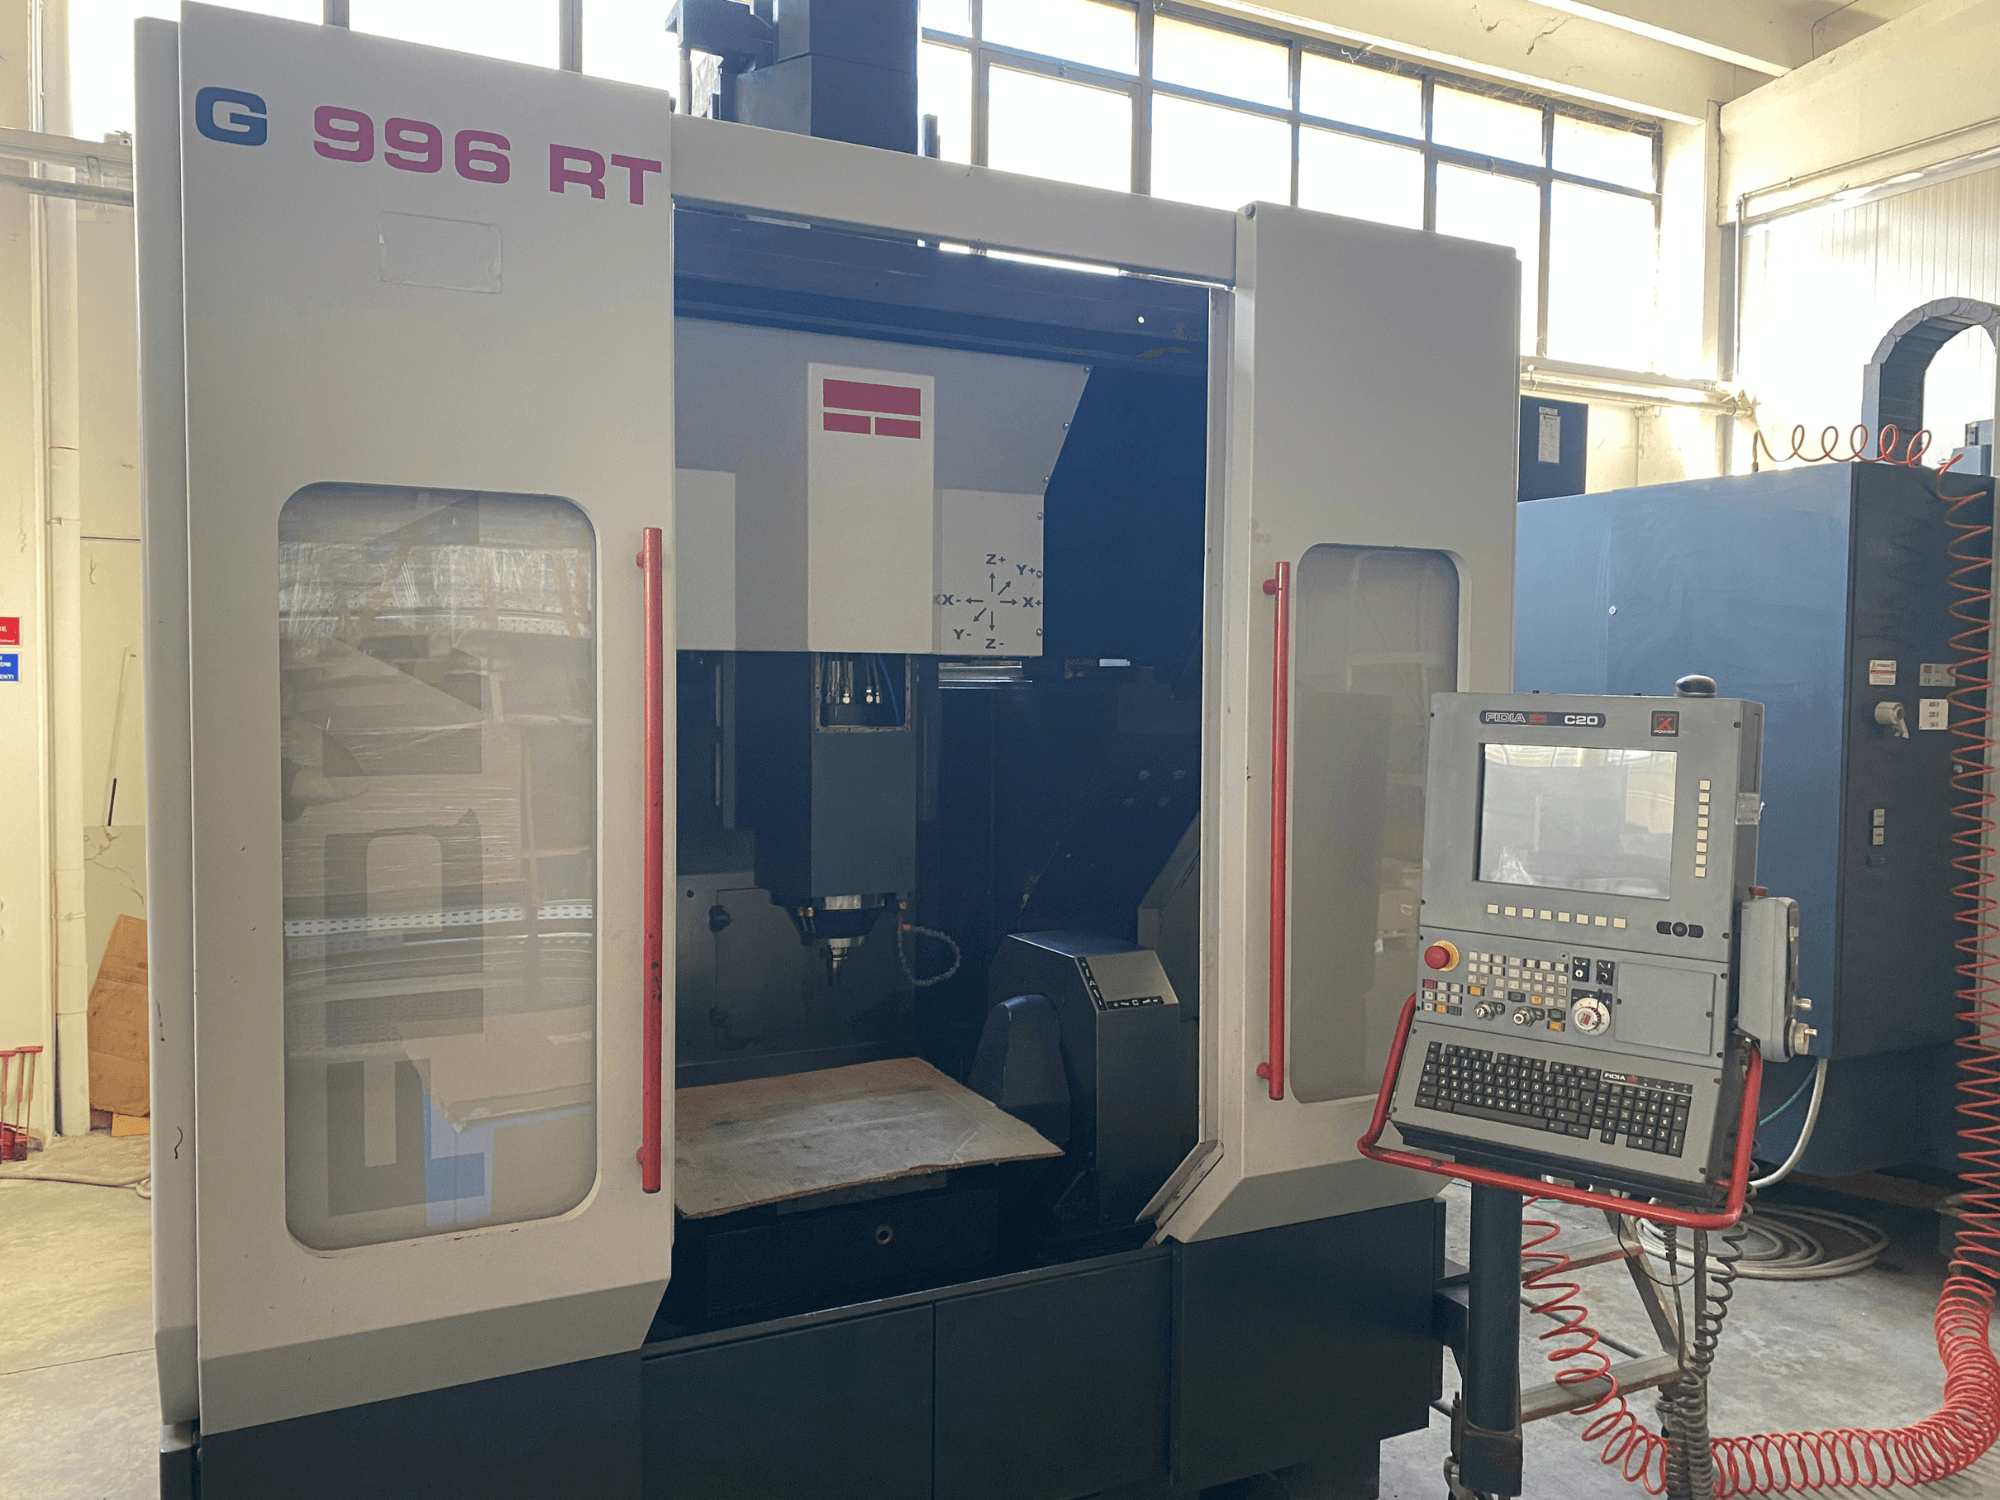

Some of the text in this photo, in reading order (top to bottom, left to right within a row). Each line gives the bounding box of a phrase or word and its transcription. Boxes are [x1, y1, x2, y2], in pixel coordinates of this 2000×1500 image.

[195, 86, 662, 205] G 996 RT
[986, 553, 1006, 565] Z+
[1022, 596, 1042, 608] X+
[1485, 712, 1599, 726] FIDIA C20
[1604, 1072, 1626, 1081] FIDIA
